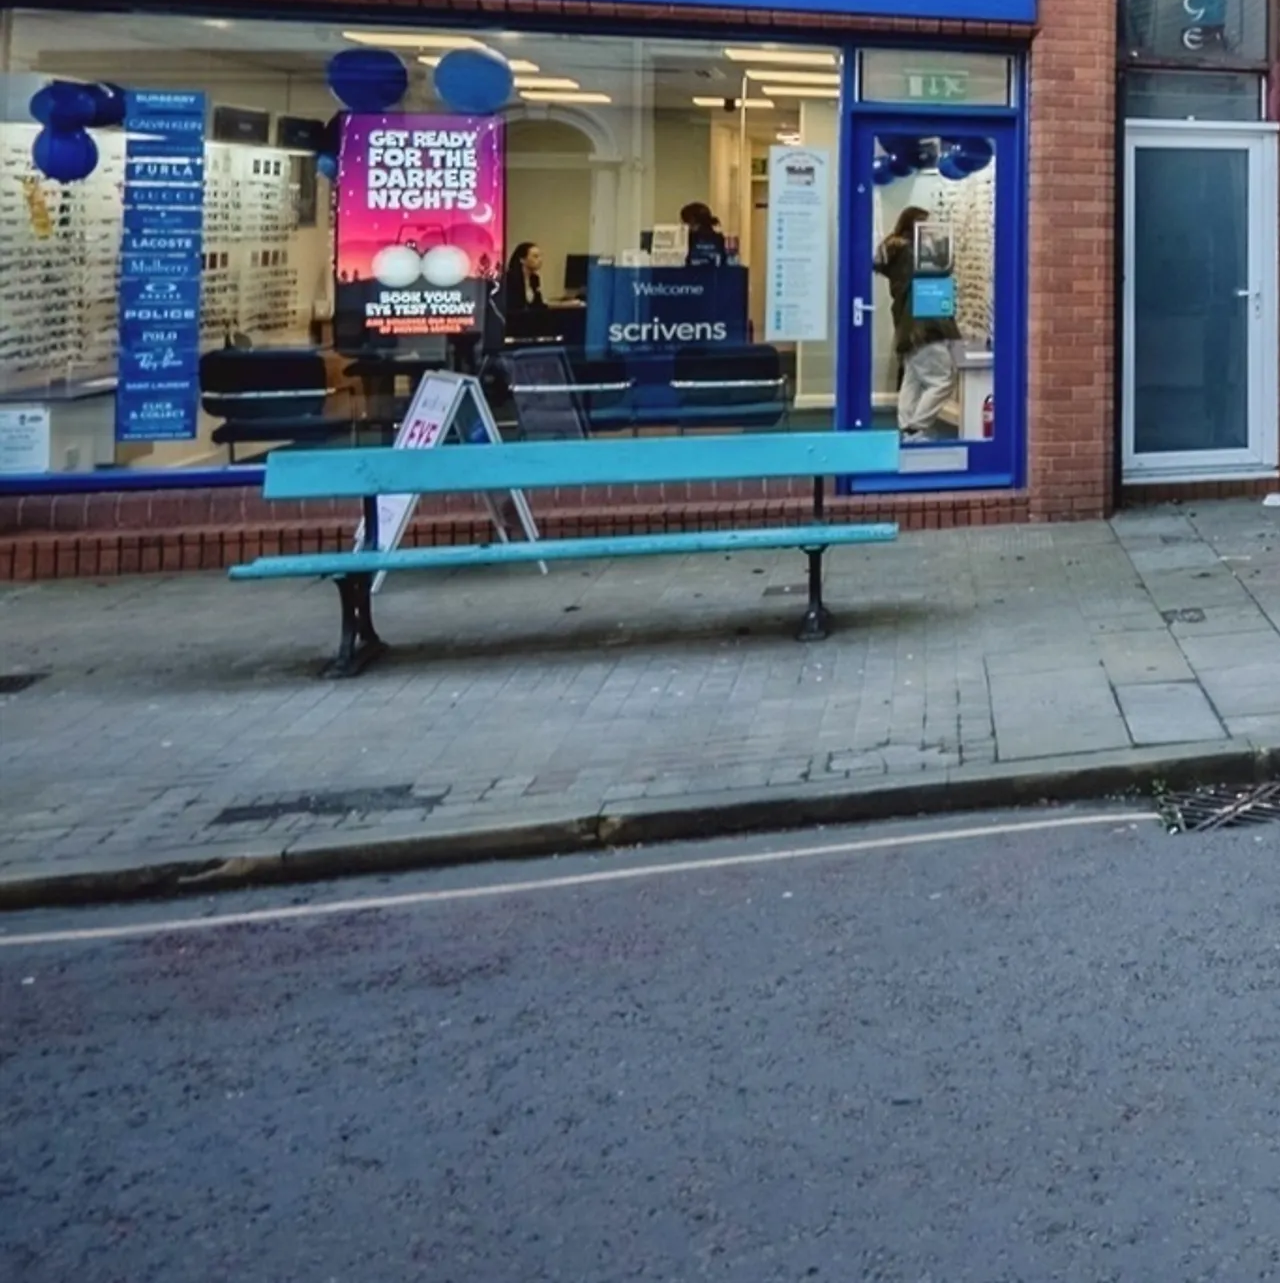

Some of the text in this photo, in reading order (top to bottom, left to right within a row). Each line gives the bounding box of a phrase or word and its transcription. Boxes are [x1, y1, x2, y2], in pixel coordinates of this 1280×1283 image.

[368, 130, 477, 148] GET READY
[369, 148, 477, 167] FOR THE
[134, 165, 193, 176] FURLA
[368, 169, 477, 188] DARKER
[367, 189, 477, 210] NIGHTS
[131, 238, 192, 249] LACOSTE
[131, 259, 189, 276] Mulberry
[632, 281, 704, 296] Welcome
[380, 291, 462, 304] BOOK YOUR
[125, 309, 195, 320] POLICE
[365, 302, 475, 316] EYE TEST TODAY
[608, 316, 727, 342] scrivens
